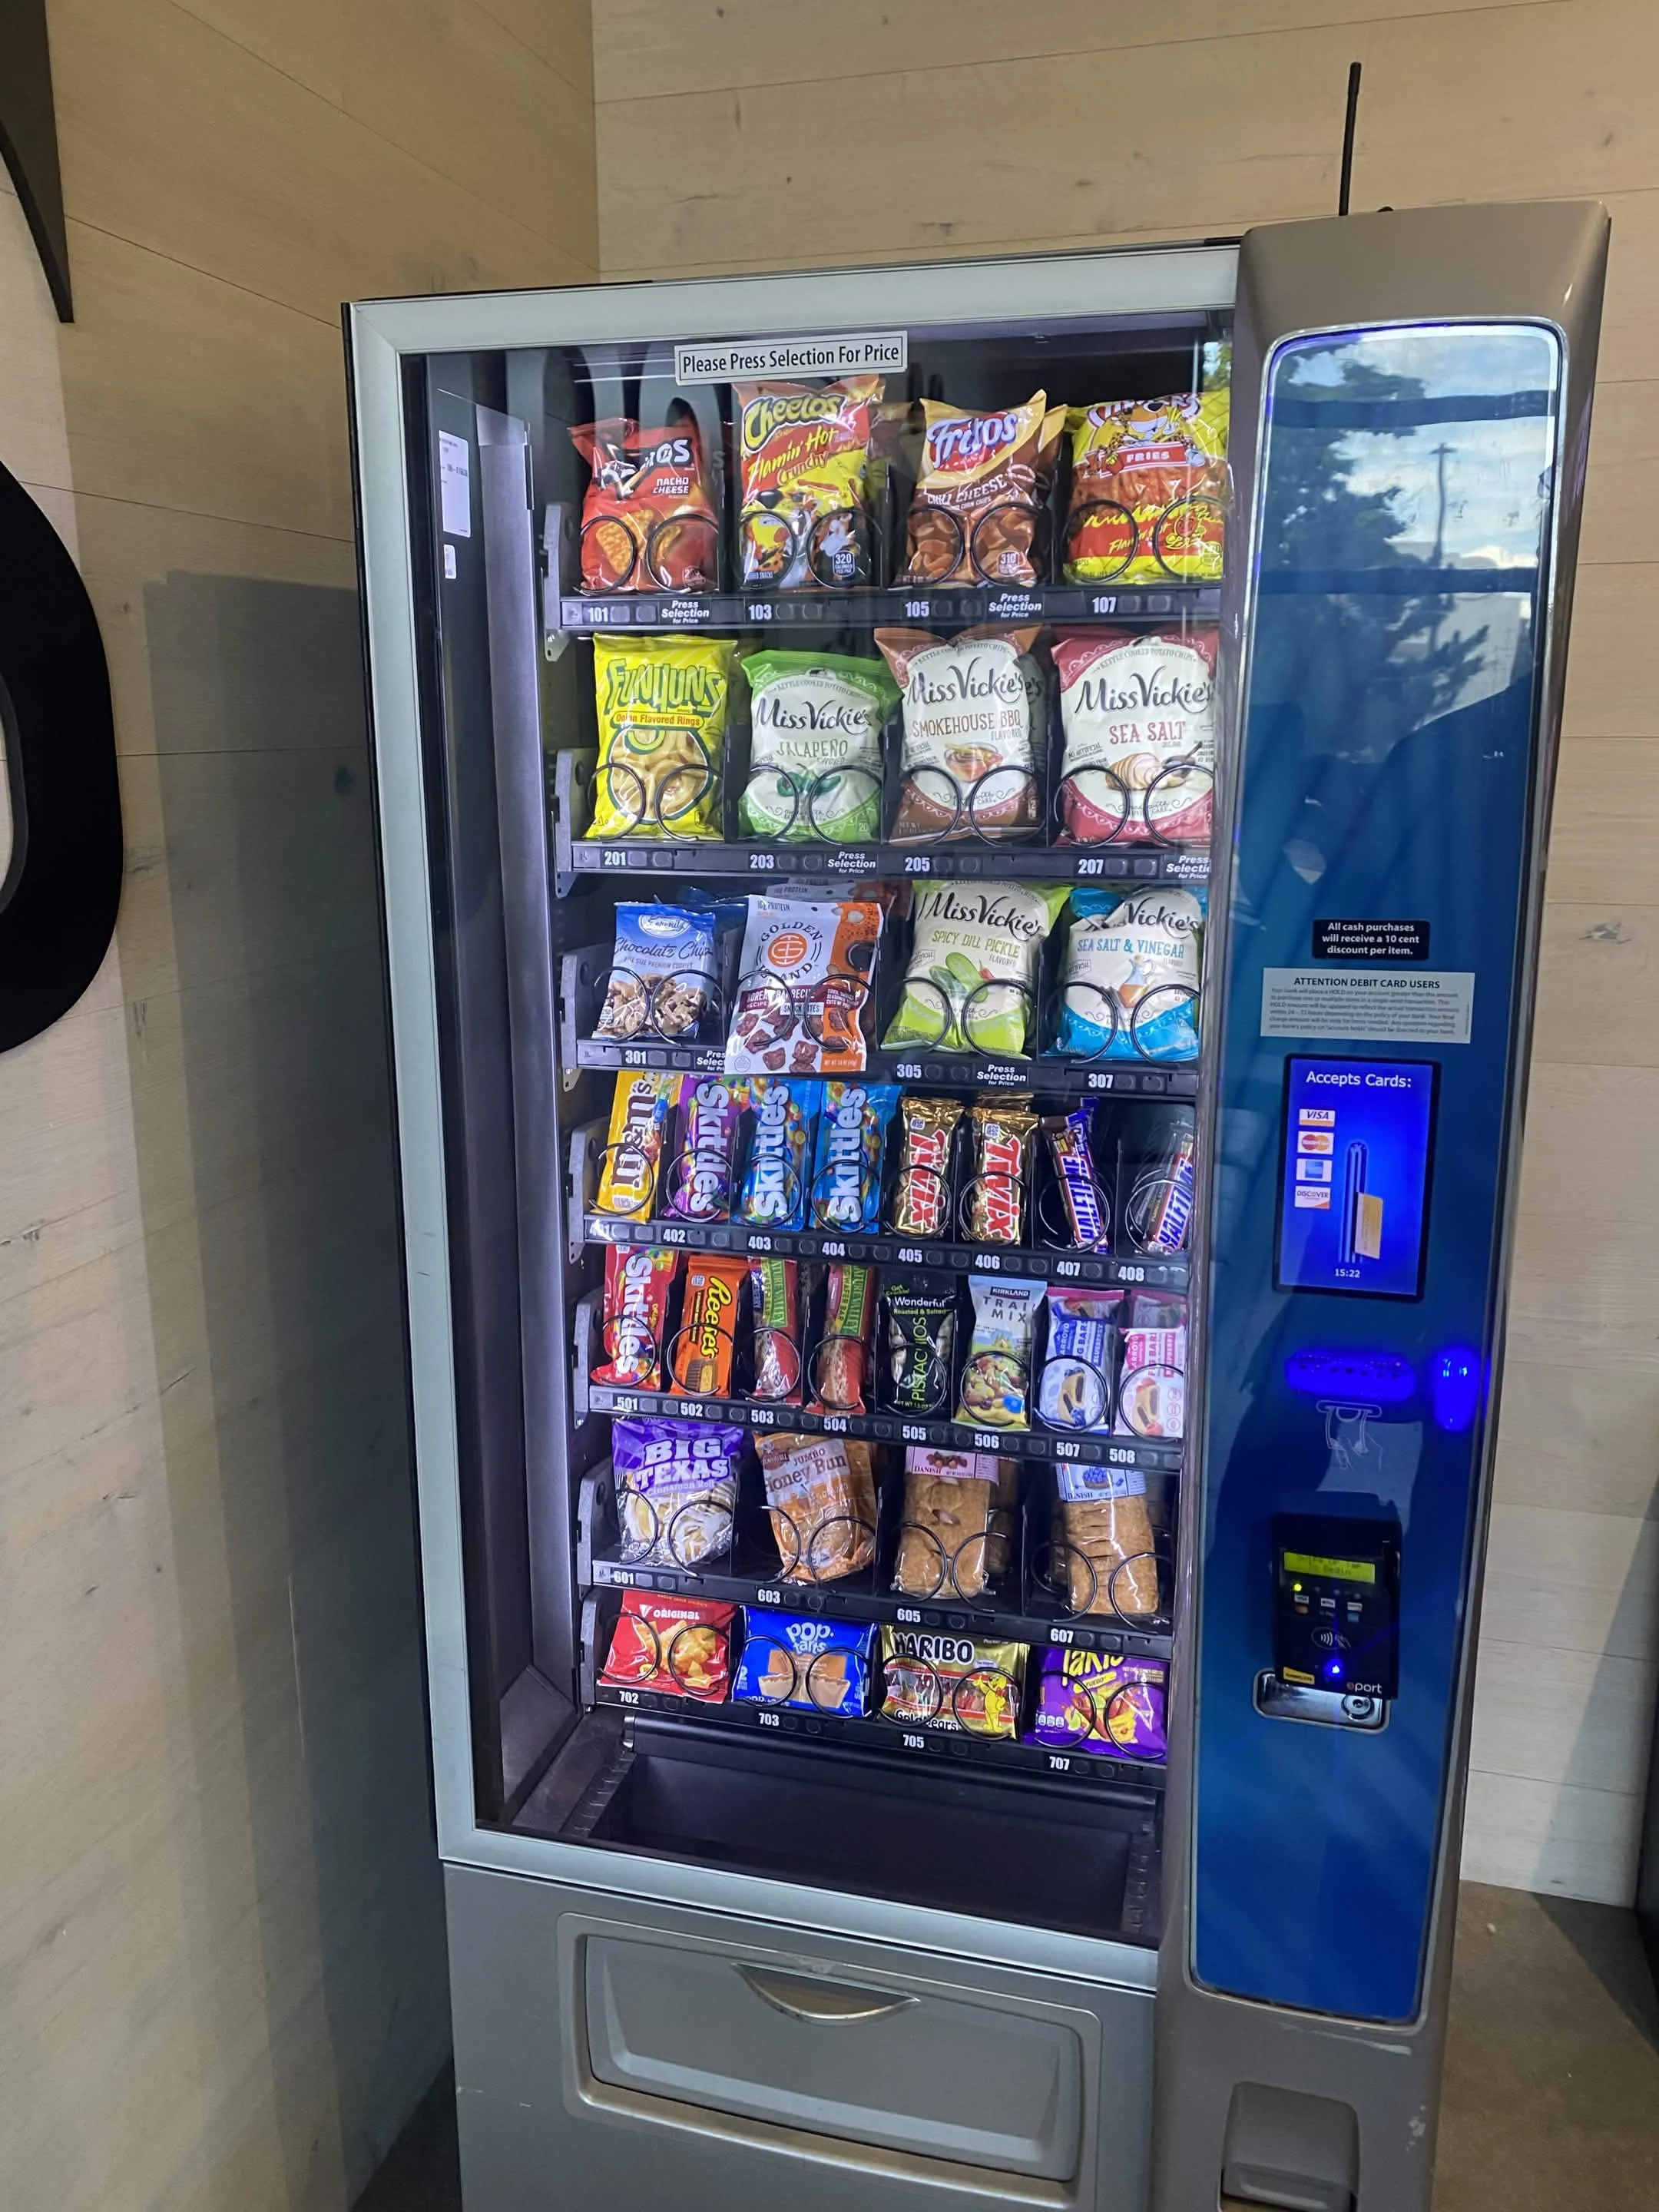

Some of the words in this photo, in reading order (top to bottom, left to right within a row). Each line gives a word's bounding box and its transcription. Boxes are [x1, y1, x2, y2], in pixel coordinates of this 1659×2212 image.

[682, 356, 727, 374] Please
[730, 352, 767, 371] Press
[769, 348, 835, 367] Selection
[838, 346, 861, 363] For
[865, 344, 899, 363] Price
[744, 395, 843, 450] Cheetos
[926, 413, 1018, 469] Fritos
[747, 441, 803, 483] Flamin'
[806, 426, 838, 449] Hot
[1126, 451, 1170, 463] FRIES
[777, 452, 830, 486] Crunchy
[656, 476, 690, 486] NACHO
[652, 485, 690, 495] CHEESE
[955, 474, 1008, 504] CHEESE
[835, 553, 853, 565] 320
[999, 552, 1018, 564] 310
[671, 600, 699, 610] Press
[1000, 592, 1030, 603] Press
[748, 604, 773, 621] 103
[905, 601, 930, 618] 105
[988, 601, 1042, 613] Selection
[1092, 597, 1117, 614] 107
[588, 606, 609, 623] 101
[661, 608, 710, 619] Selection
[906, 671, 957, 707] Miss
[946, 657, 1024, 704] Vickie's
[1075, 677, 1138, 714] Miss
[639, 713, 674, 725] Flavored
[676, 715, 700, 727] Rings
[755, 697, 807, 729] Miss
[801, 700, 872, 735] Vickie's
[912, 713, 995, 738] SMOKEHOUSE
[1000, 709, 1024, 730] BBQ
[1108, 724, 1141, 745] SEA
[1147, 720, 1185, 741] SALT
[776, 739, 848, 758] JALAPEÑO
[604, 851, 627, 866] 201
[749, 854, 774, 869] 203
[838, 851, 866, 859] Press
[1178, 855, 1210, 864] Press
[827, 859, 876, 869] Selection
[905, 856, 931, 872] 205
[1078, 859, 1104, 874] 207
[767, 902, 791, 912] PROTEIN
[917, 892, 979, 922] Miss
[976, 895, 1045, 942] Vickie's
[1124, 896, 1200, 939] Vickie's
[760, 921, 823, 943] GOLDEN
[1328, 922, 1341, 931] All
[1366, 923, 1415, 934] purchases
[932, 929, 960, 944] SPICY
[961, 933, 981, 949] DILL
[985, 937, 1022, 959] PICKLE
[1322, 934, 1339, 942] will
[1341, 935, 1375, 943] receive
[1386, 935, 1397, 943] 10
[1398, 935, 1419, 944] cent
[614, 936, 677, 959] Chocolate
[1077, 939, 1094, 952] SEA
[1096, 938, 1121, 952] SALT
[1123, 939, 1133, 953] &
[1137, 939, 1185, 959] VINEGAR
[1326, 945, 1368, 955] discount
[1369, 947, 1386, 956] per
[1388, 946, 1413, 955] item.
[1293, 976, 1348, 987] ATTENTION
[1349, 978, 1378, 987] DEBIT
[1380, 979, 1407, 988] CARD
[1409, 979, 1441, 989] USERS
[624, 1049, 647, 1065] 301
[896, 1063, 922, 1079] 305
[988, 1064, 1015, 1073] Press
[976, 1071, 1027, 1082] Selection
[1088, 1073, 1114, 1088] 307
[1306, 1070, 1361, 1086] Accepts
[1365, 1073, 1412, 1088] Cards:
[1306, 1110, 1330, 1120] VISA
[1296, 1190, 1330, 1200] DISCOVER
[663, 1228, 686, 1243] 402
[748, 1236, 772, 1250] 403
[822, 1242, 846, 1257] 404
[898, 1248, 922, 1263] 405
[975, 1253, 1001, 1270] 406
[1056, 1260, 1081, 1277] 407
[1118, 1266, 1144, 1282] 408
[1334, 1268, 1361, 1279] 15:22
[992, 1288, 1030, 1298] KIRKLAND
[772, 1288, 786, 1323] VALLEY
[895, 1296, 945, 1307] Wonderful
[700, 1275, 732, 1359] Reese's
[846, 1294, 864, 1333] VALLEY
[991, 1309, 1027, 1323] MIX
[1058, 1323, 1070, 1356] ARROYO
[617, 1397, 638, 1411] 501
[680, 1403, 703, 1417] 502
[751, 1409, 774, 1425] 503
[823, 1417, 846, 1432] 504
[902, 1426, 927, 1441] 505
[975, 1433, 999, 1449] 506
[644, 1437, 722, 1466] BIG
[793, 1447, 827, 1467] JUMBO
[1056, 1442, 1081, 1458] 507
[1109, 1449, 1136, 1464] 508
[813, 1454, 847, 1476] Bun
[913, 1465, 942, 1475] DANISH
[636, 1458, 730, 1492] TEXAS
[757, 1588, 782, 1604] 603
[653, 1608, 700, 1621] ORIGINAL
[896, 1608, 922, 1623] 605
[1050, 1628, 1075, 1644] 607
[793, 1639, 829, 1655] tarts
[892, 1631, 975, 1665] HARIBO
[619, 1690, 639, 1704] 702
[758, 1713, 780, 1727] 703
[902, 1734, 925, 1749] 705
[1049, 1756, 1070, 1771] 707
